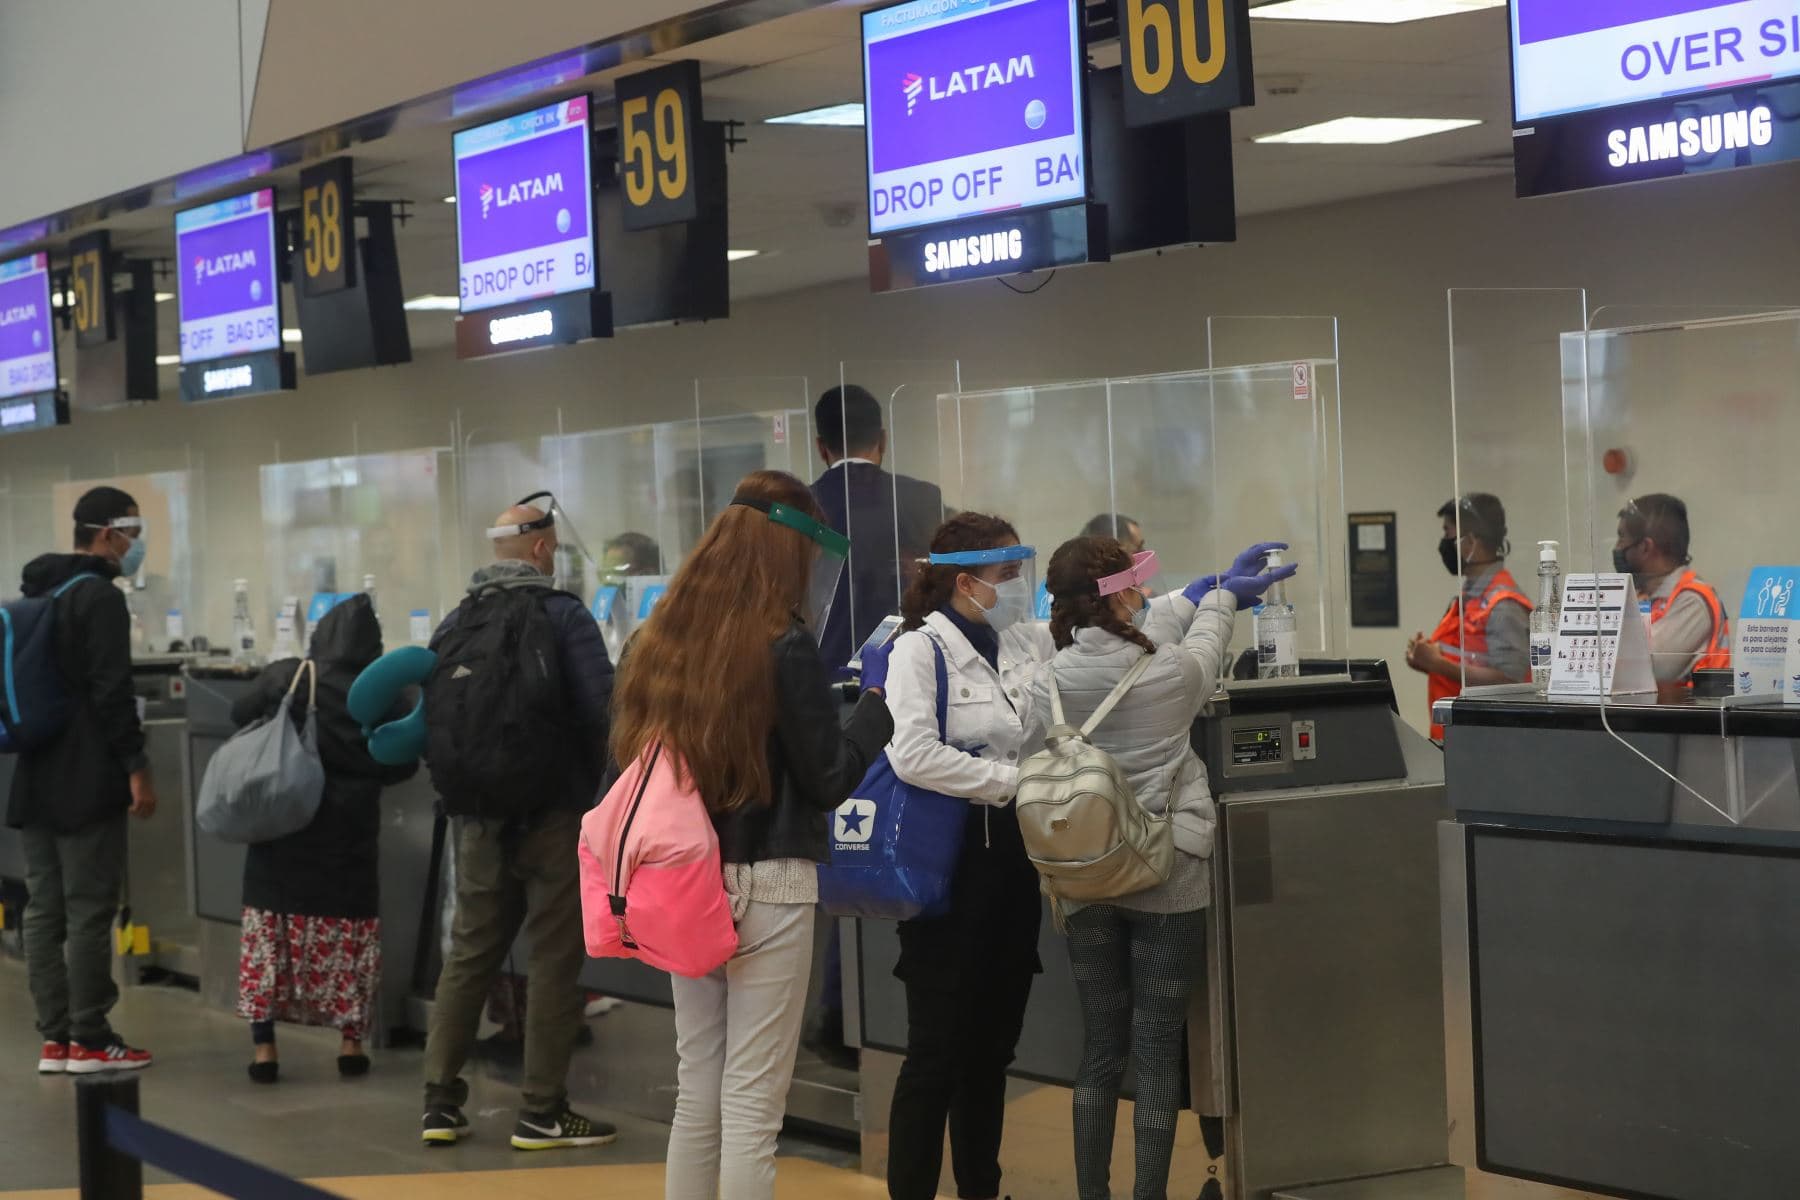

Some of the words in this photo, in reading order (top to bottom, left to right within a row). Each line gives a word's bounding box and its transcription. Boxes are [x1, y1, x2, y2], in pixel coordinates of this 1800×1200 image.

[1126, 0, 1226, 94] 60
[1620, 27, 1744, 81] OVER
[929, 54, 1035, 101] LATAM
[623, 88, 687, 206] 59
[1607, 106, 1772, 167] SAMSUNG
[497, 172, 563, 207] LATAM
[873, 178, 944, 216] DROP
[952, 165, 1003, 201] OFF
[303, 181, 342, 278] 58
[925, 229, 1022, 272] SAMSUNG
[206, 249, 256, 277] LATAM
[473, 266, 518, 296] DROP
[523, 258, 555, 286] OFF
[72, 249, 100, 332] 57
[0, 304, 37, 327] LATAM
[191, 328, 215, 350] OFF
[226, 321, 254, 344] BAG
